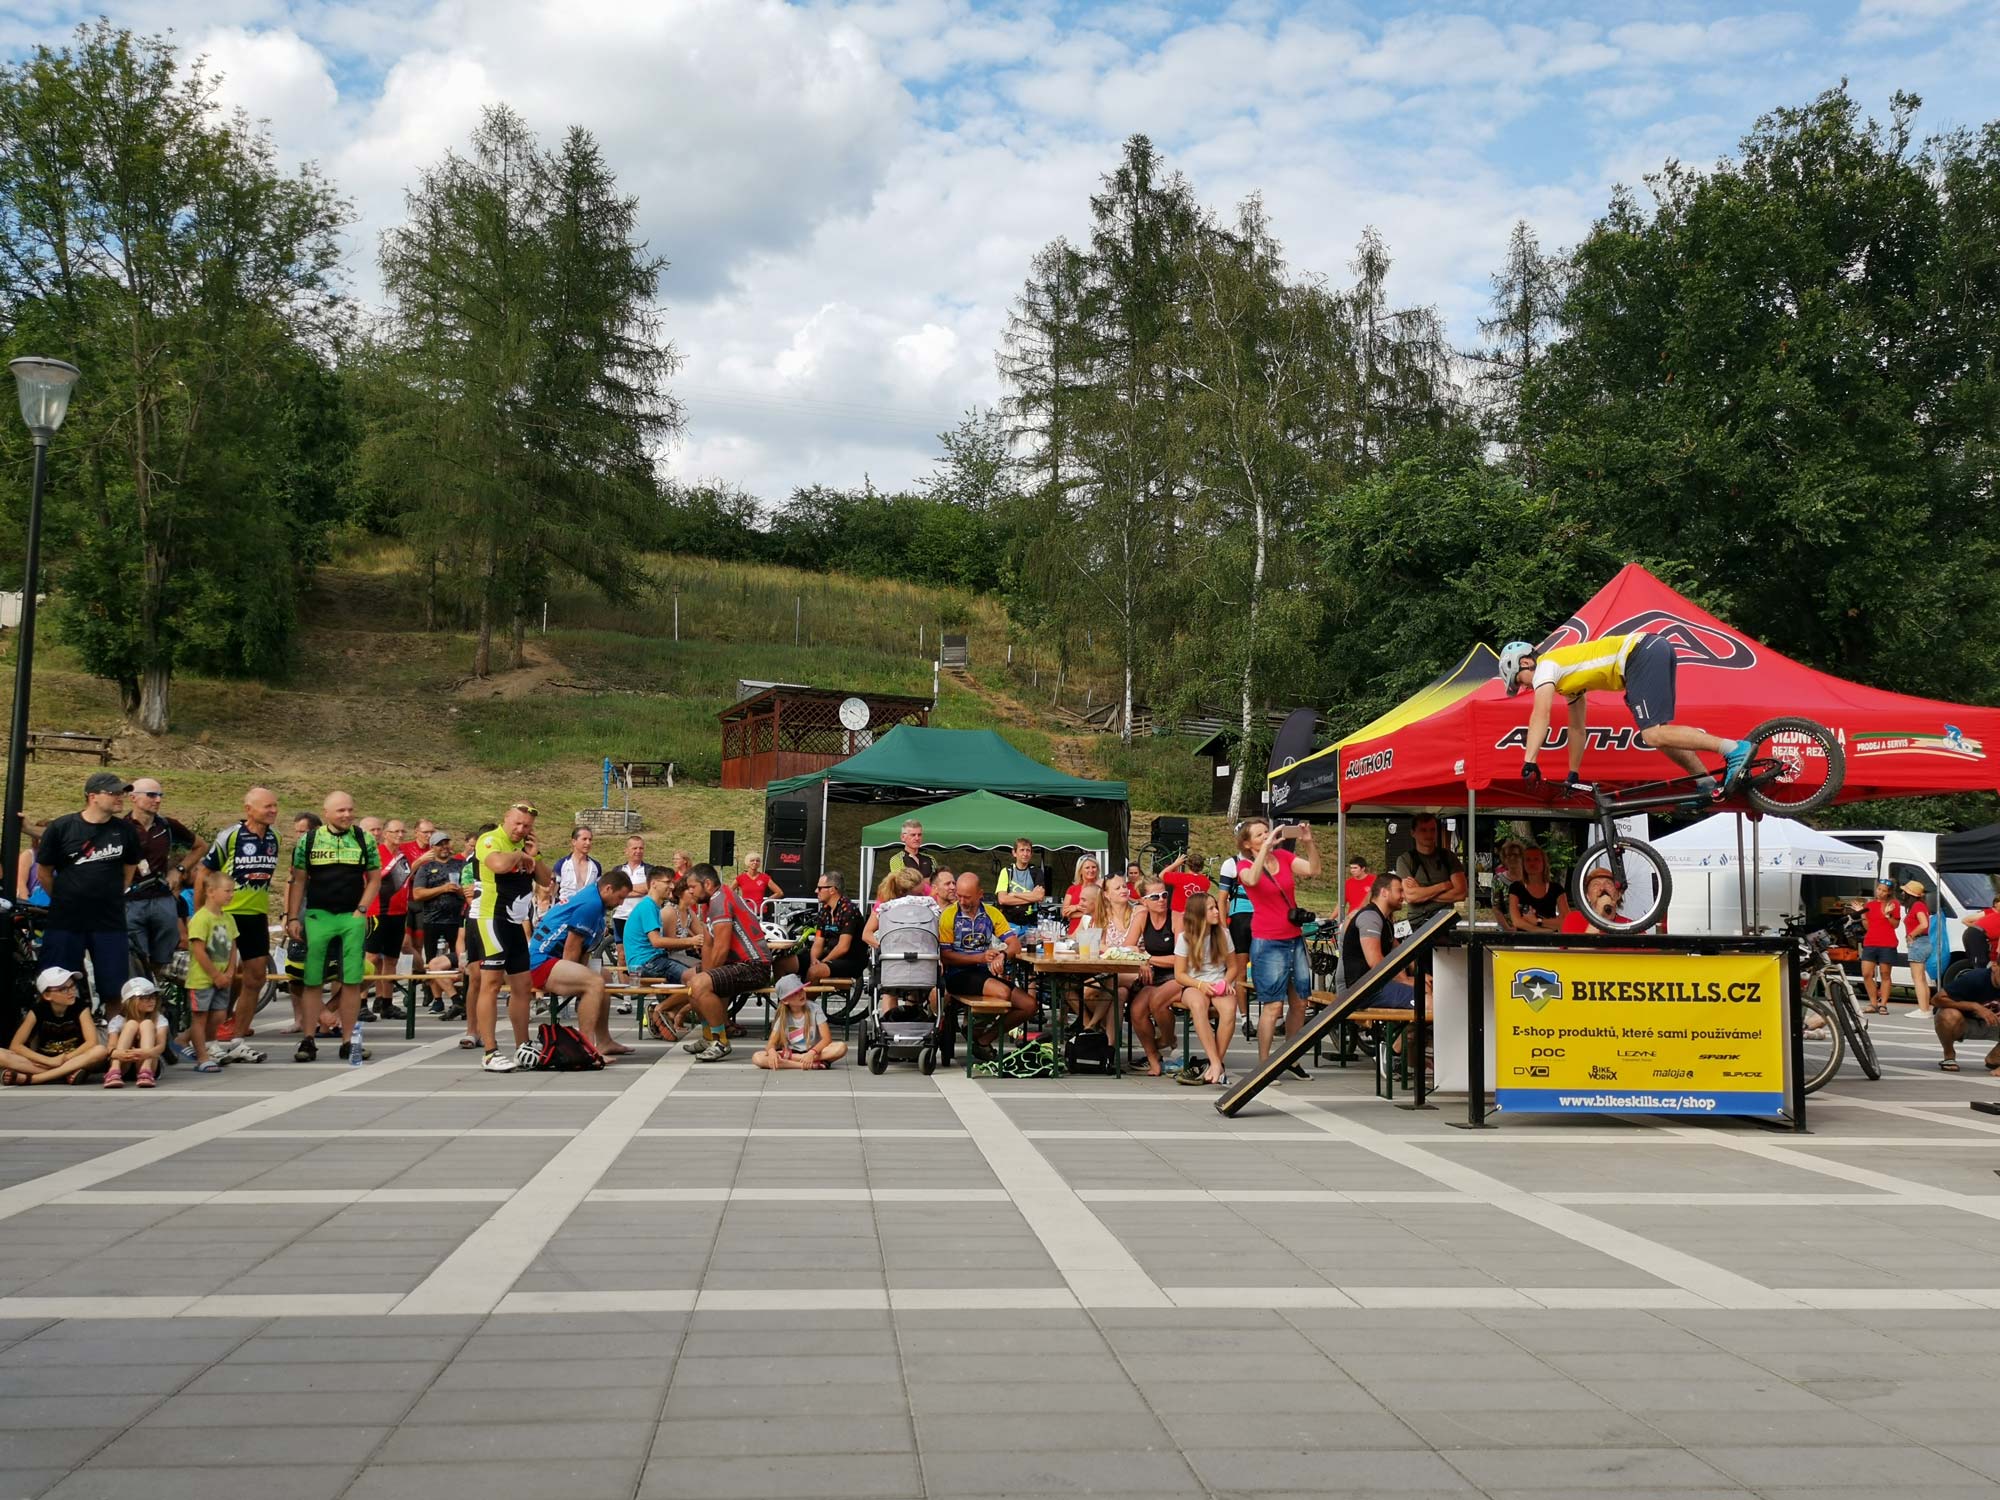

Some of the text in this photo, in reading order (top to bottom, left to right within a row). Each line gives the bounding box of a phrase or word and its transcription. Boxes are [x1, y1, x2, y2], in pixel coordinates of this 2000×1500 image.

[1857, 739, 1909, 751] PRODEJ A SERVIS
[1345, 748, 1393, 780] AUTHOR
[1571, 981, 1761, 1003] BIKESKILLS.CZ
[1512, 1026, 1762, 1041] E-shop produktů, které sami používáme!
[1652, 1069, 1685, 1079] maloja
[1558, 1095, 1716, 1110] www.bikeskills.cz/shop
